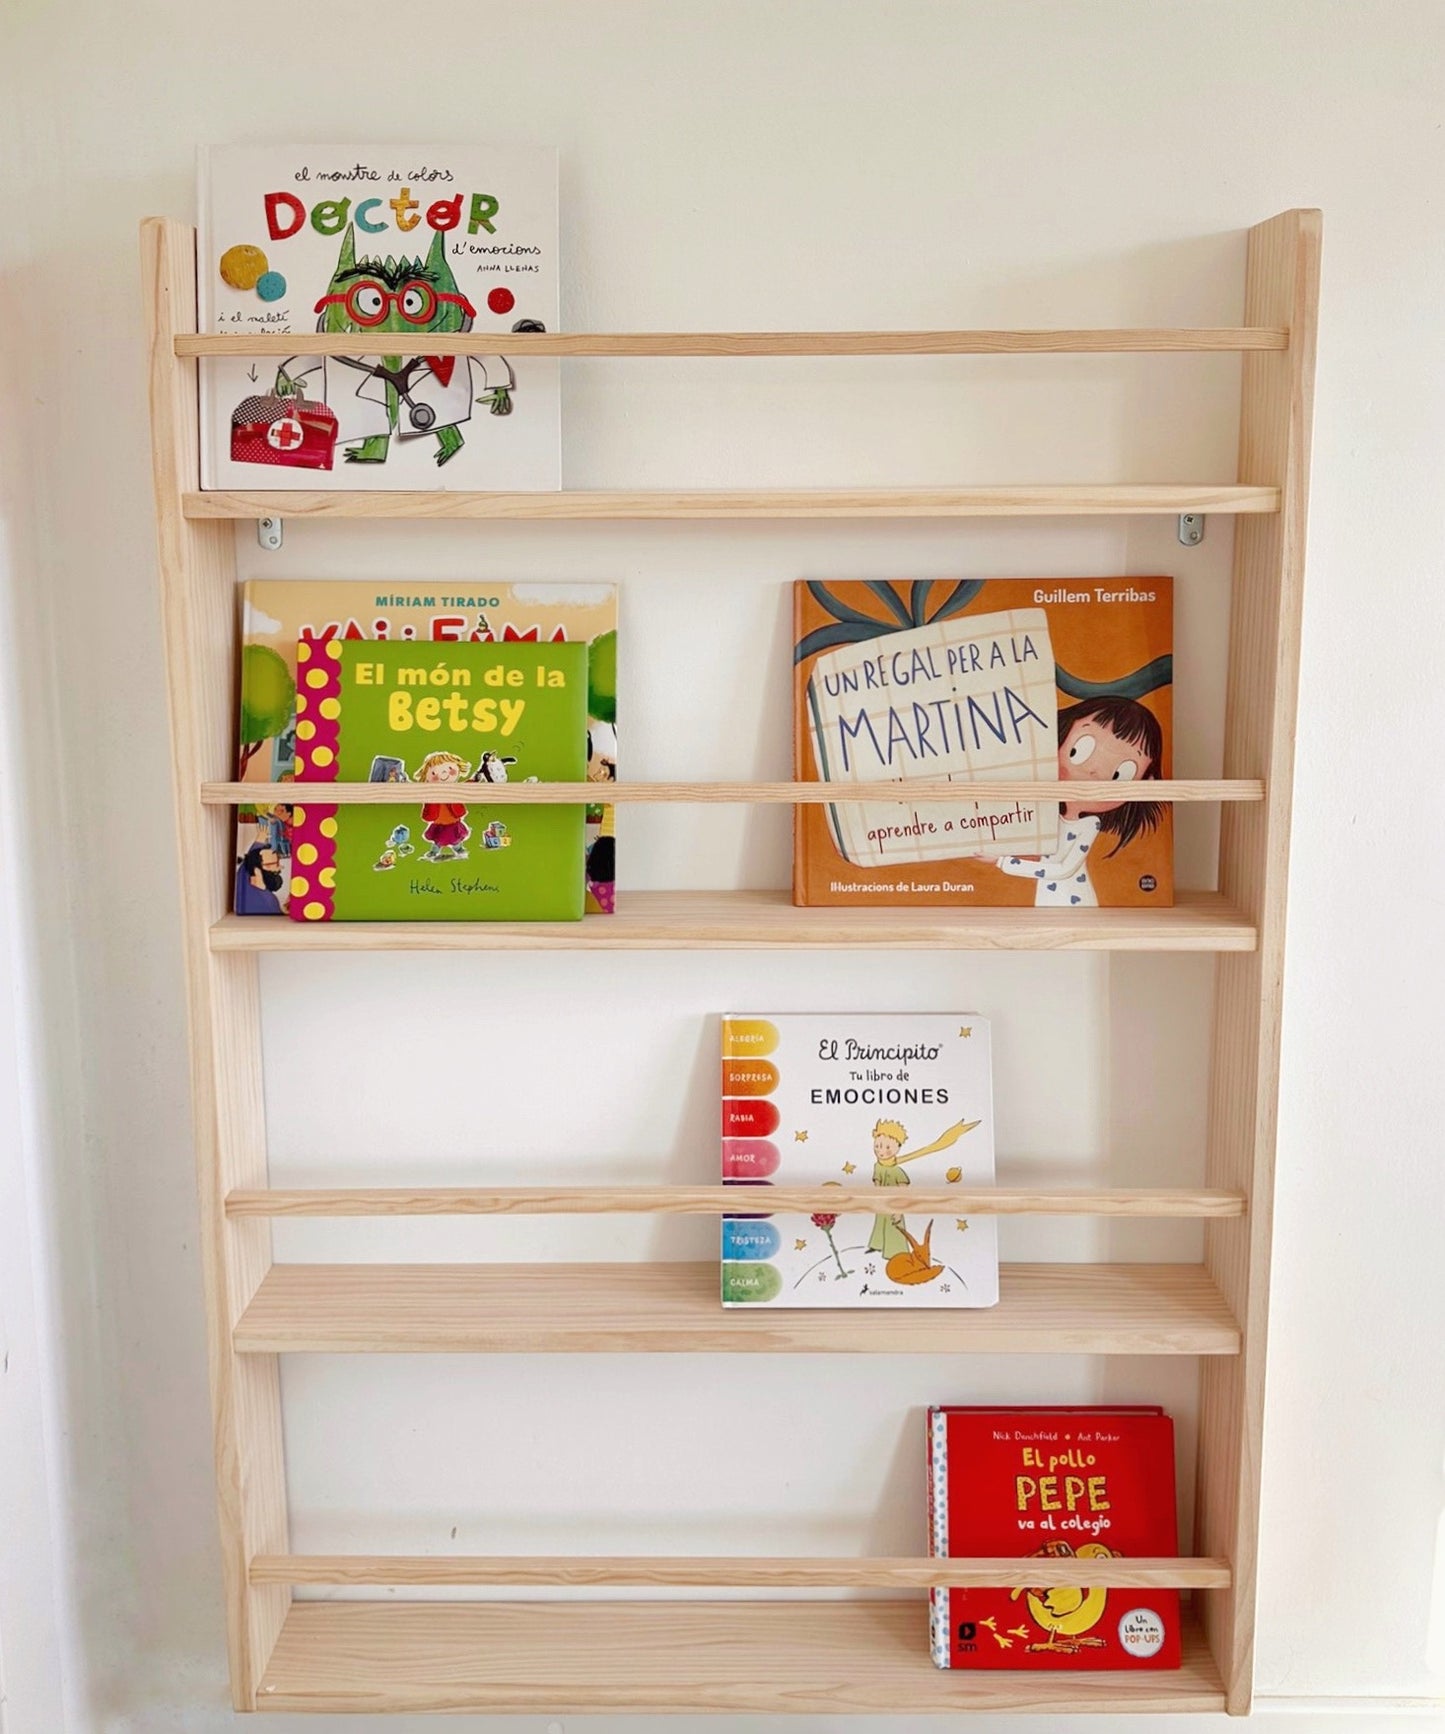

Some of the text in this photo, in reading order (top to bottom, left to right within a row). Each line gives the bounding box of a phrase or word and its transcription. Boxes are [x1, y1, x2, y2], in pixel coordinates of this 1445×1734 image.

[295, 164, 454, 182] el monstre de colors
[477, 265, 540, 273] ANNA LLENAS
[375, 593, 500, 608] MÍRIAM TIRADO
[1033, 588, 1156, 604] Guillem Terribas
[355, 662, 566, 688] El món de la
[824, 634, 1039, 697] UN REGAL PER A LA
[388, 691, 525, 736] Betsy
[867, 801, 1034, 854] aprendre a compartir
[896, 882, 909, 893] de
[911, 882, 940, 893] Laura
[942, 882, 974, 893] Duran
[818, 1039, 838, 1061] El
[850, 1070, 909, 1081] Tu libro de
[811, 1089, 949, 1104] EMOCIONES
[729, 1153, 755, 1162] AMOR
[1023, 1448, 1096, 1472] El pollo
[1016, 1476, 1111, 1511] PEPE
[1018, 1515, 1111, 1536] va al colegio
